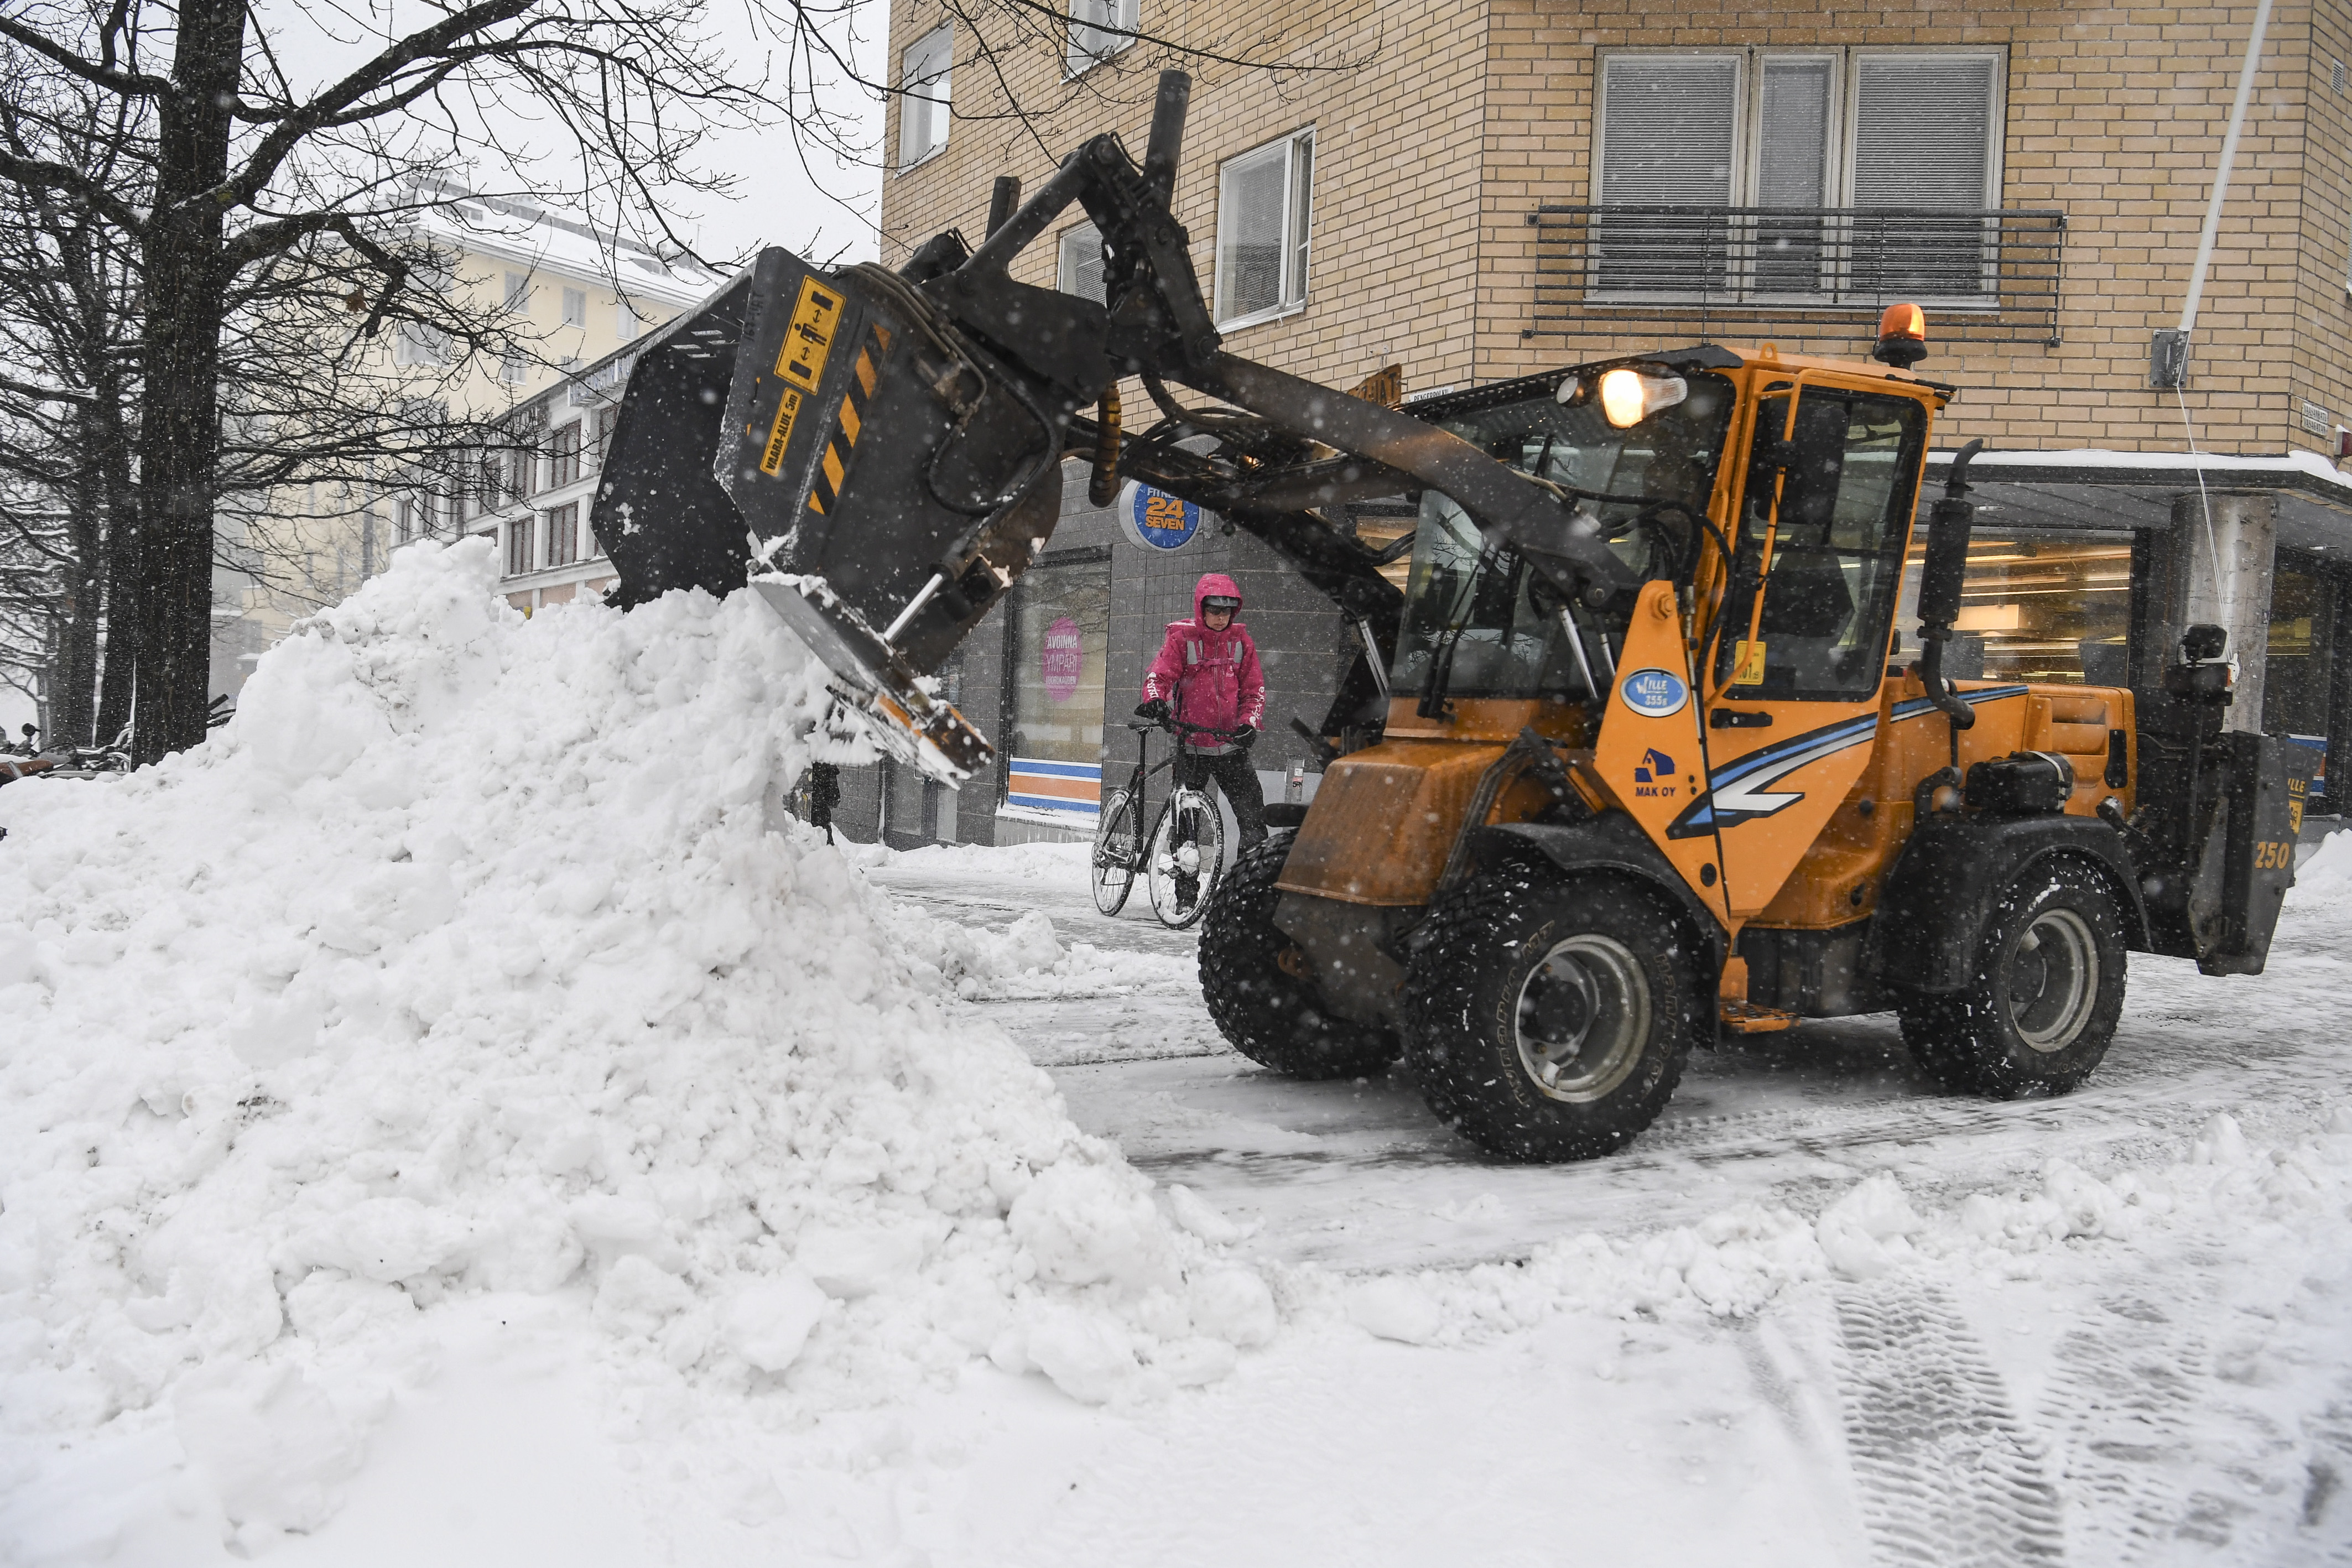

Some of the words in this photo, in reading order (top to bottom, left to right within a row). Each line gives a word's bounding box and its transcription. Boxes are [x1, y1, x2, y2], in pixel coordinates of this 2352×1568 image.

[766, 412, 792, 470] VAARA-ALUE
[785, 394, 798, 411] 5m
[1146, 497, 1185, 519] 24
[1145, 515, 1185, 531] SEVEN
[1047, 635, 1077, 649] AVOINNA
[1046, 650, 1077, 672] YMPÄRI
[1046, 676, 1076, 684] VUOROKAUDEN
[1636, 676, 1667, 694] WILLE
[1636, 787, 1658, 796] MAK
[1662, 787, 1676, 796] OY
[2255, 841, 2289, 869] 250
